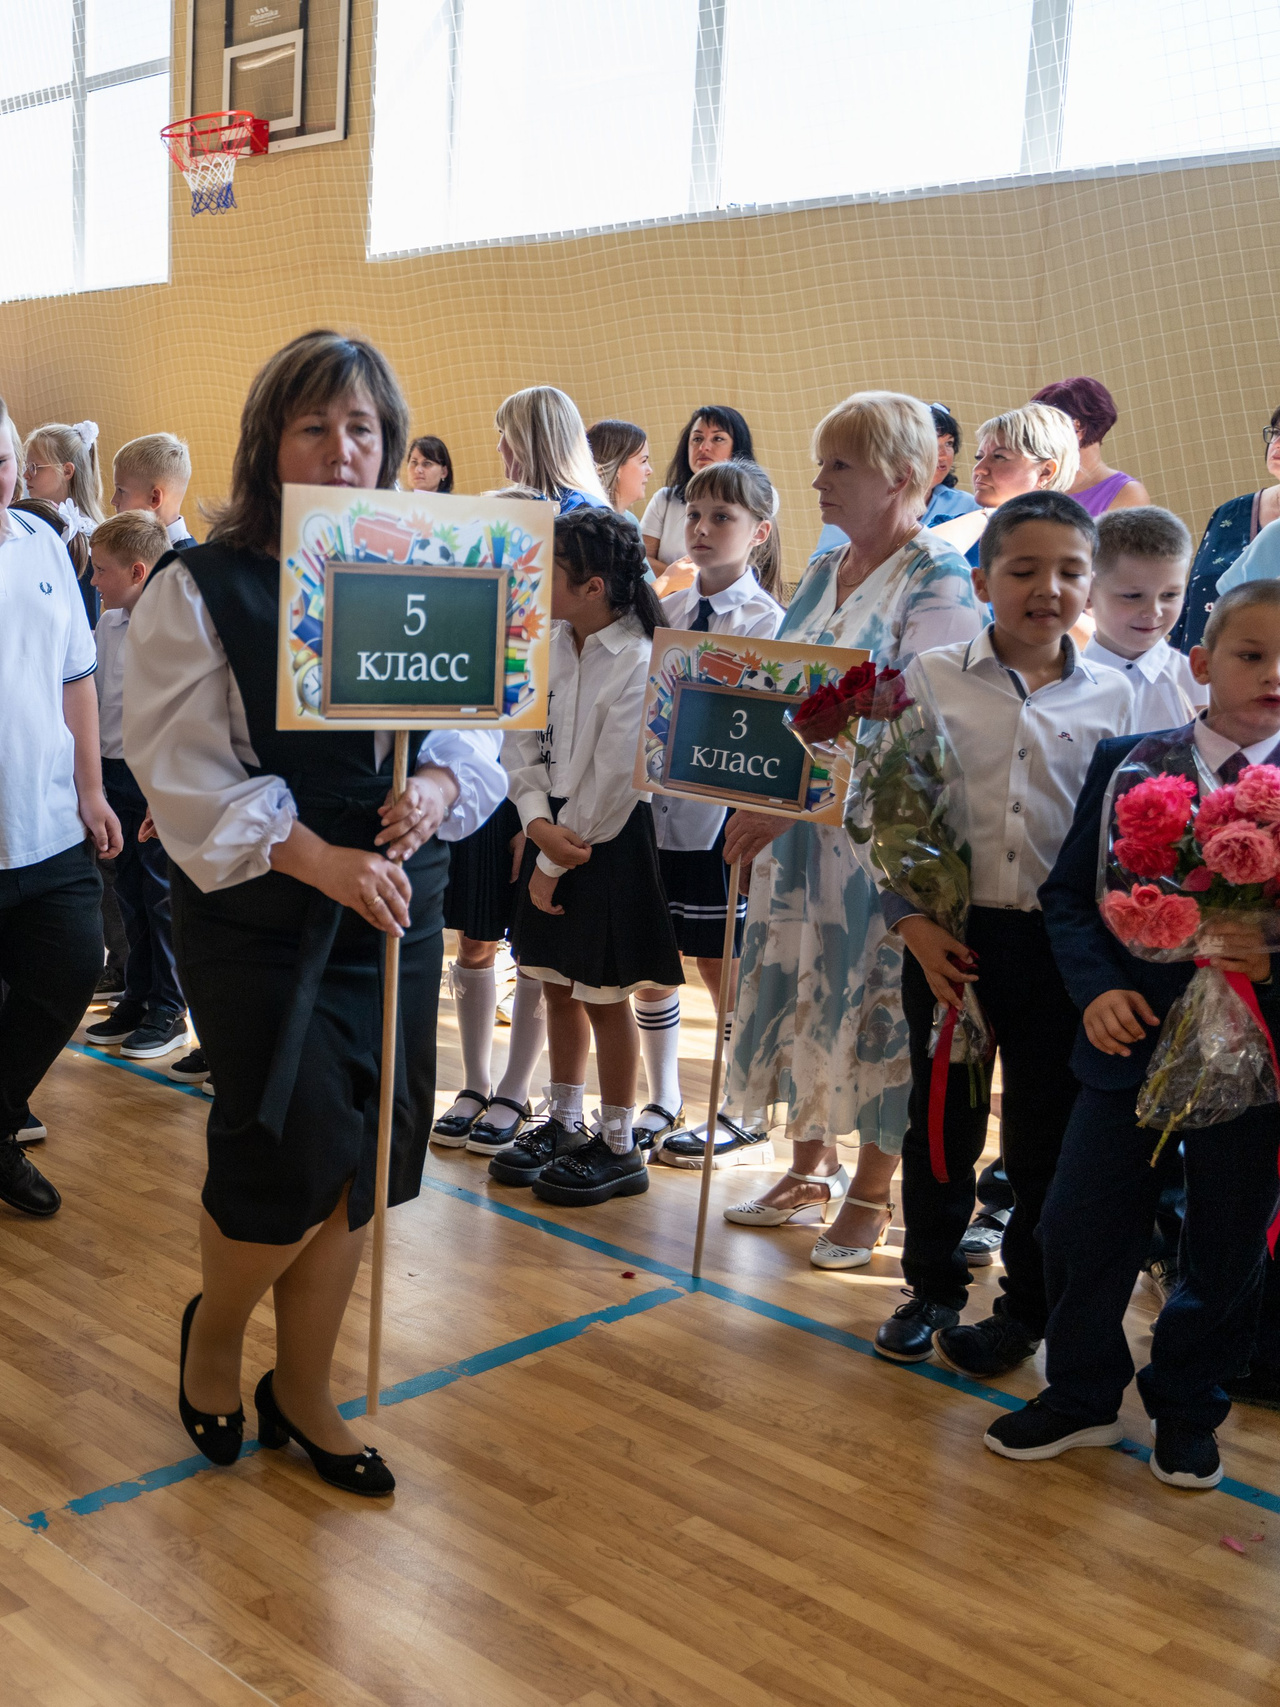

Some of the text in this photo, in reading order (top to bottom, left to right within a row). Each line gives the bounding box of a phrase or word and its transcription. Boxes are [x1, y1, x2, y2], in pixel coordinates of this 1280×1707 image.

[403, 594, 426, 636] 5
[356, 652, 469, 681] класс
[729, 709, 748, 739] 3
[689, 745, 780, 779] класс
